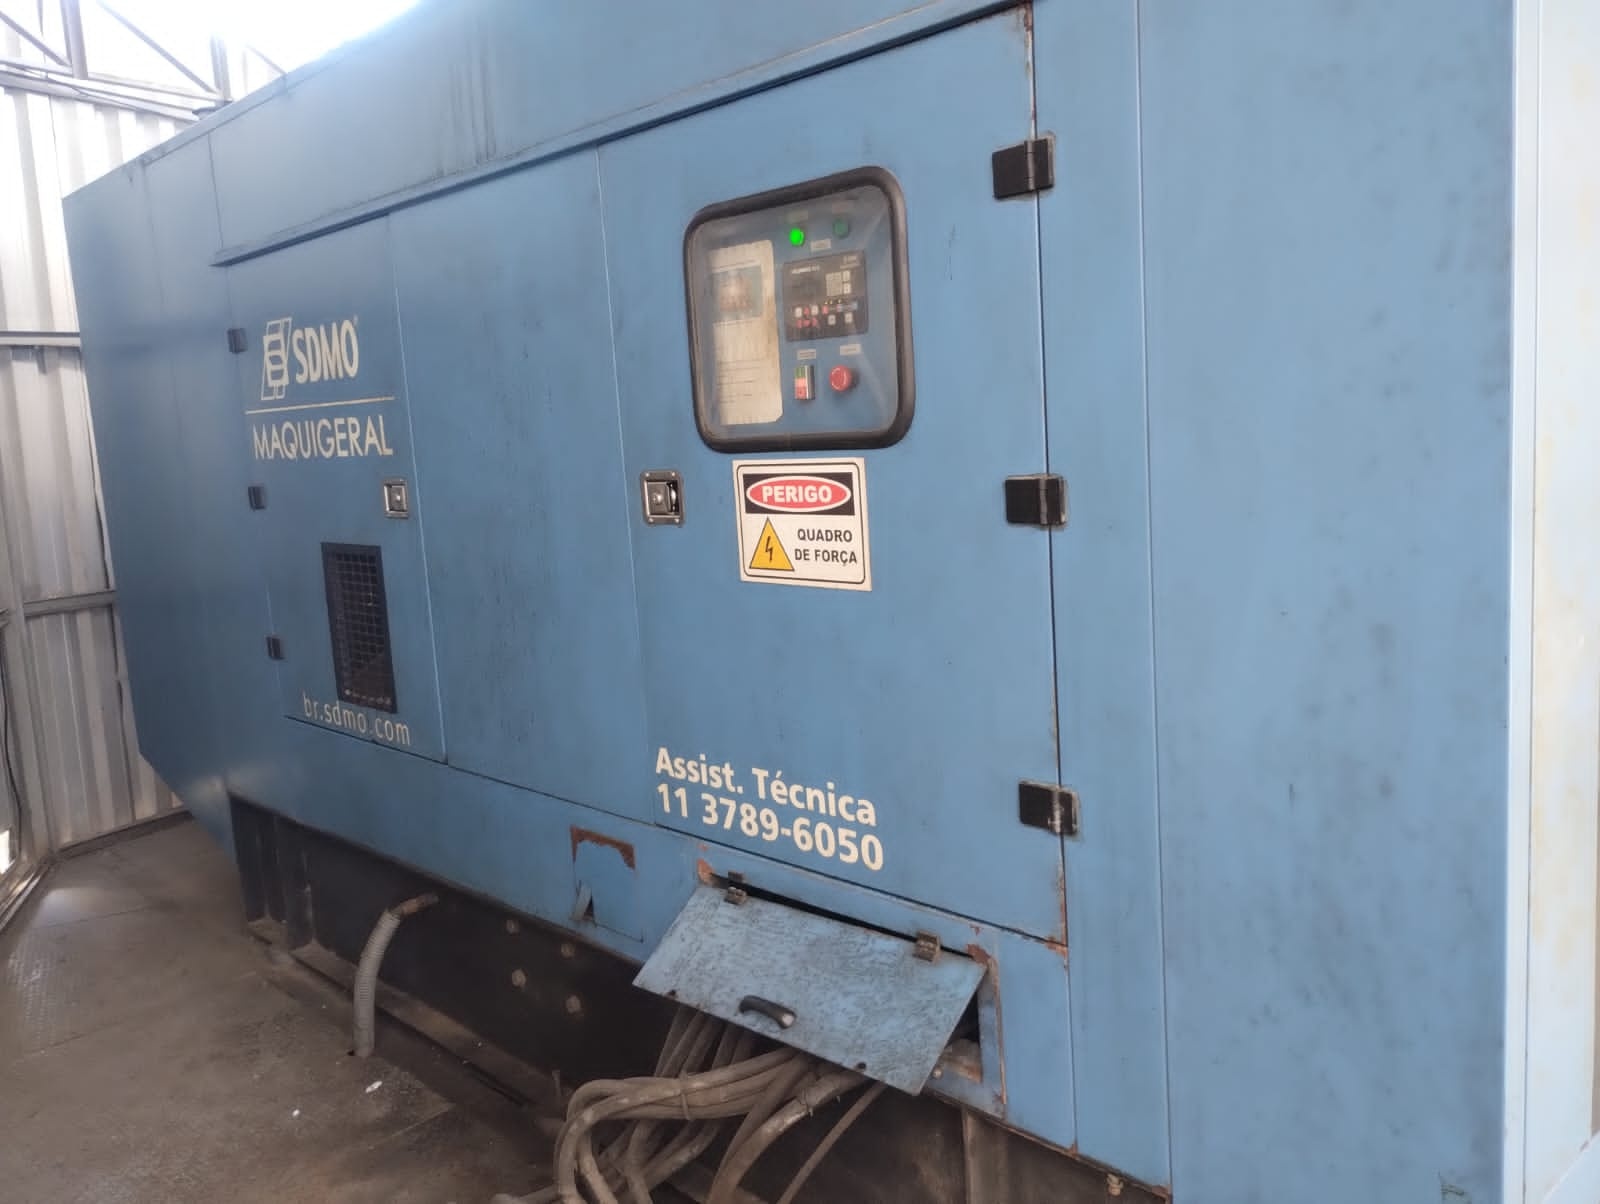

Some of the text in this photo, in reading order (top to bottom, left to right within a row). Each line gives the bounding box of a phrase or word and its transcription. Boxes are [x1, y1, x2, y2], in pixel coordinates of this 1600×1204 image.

[292, 319, 359, 384] SDMO
[253, 414, 394, 462] MAQUIGERAL
[762, 485, 833, 504] PERIGO
[794, 548, 857, 567] DE FORÇA
[797, 528, 853, 543] QUADRO
[303, 689, 410, 746] br.sdmo.com
[656, 747, 877, 827] Assist. Técnica
[657, 783, 884, 871] 11 3789-6050
